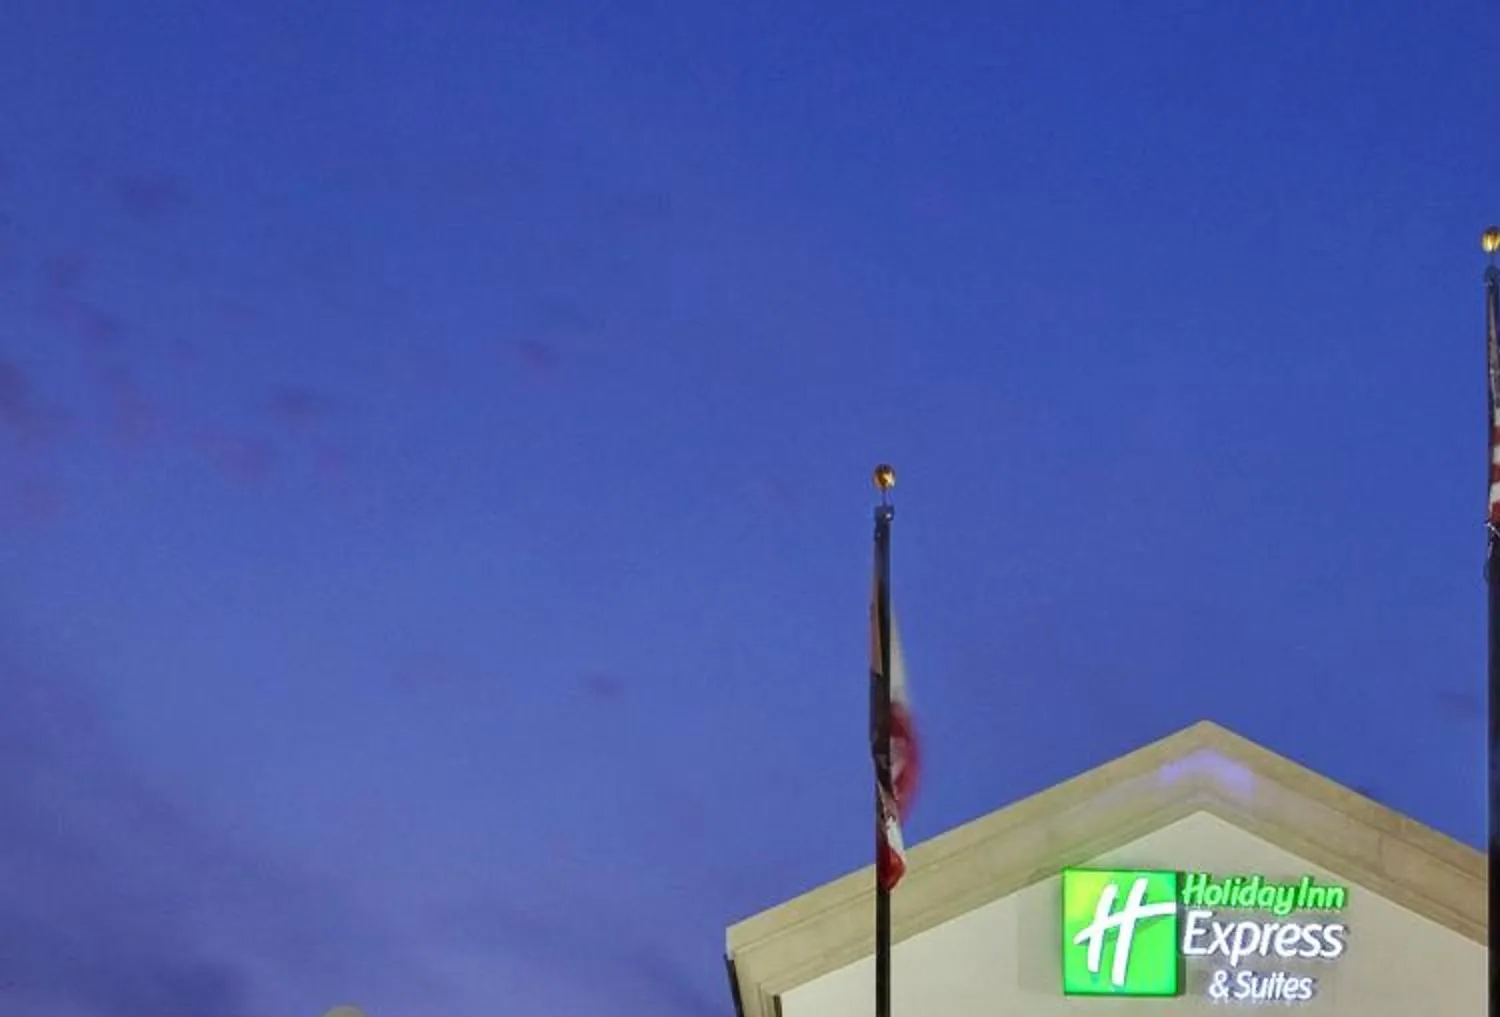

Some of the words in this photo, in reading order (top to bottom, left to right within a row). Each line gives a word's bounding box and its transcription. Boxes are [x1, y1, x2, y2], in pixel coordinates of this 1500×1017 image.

[1182, 873, 1296, 915] Holiday
[1299, 876, 1345, 909] Inn
[1183, 909, 1345, 968] Express
[1209, 969, 1229, 1000] &
[1232, 971, 1314, 1001] Suites
